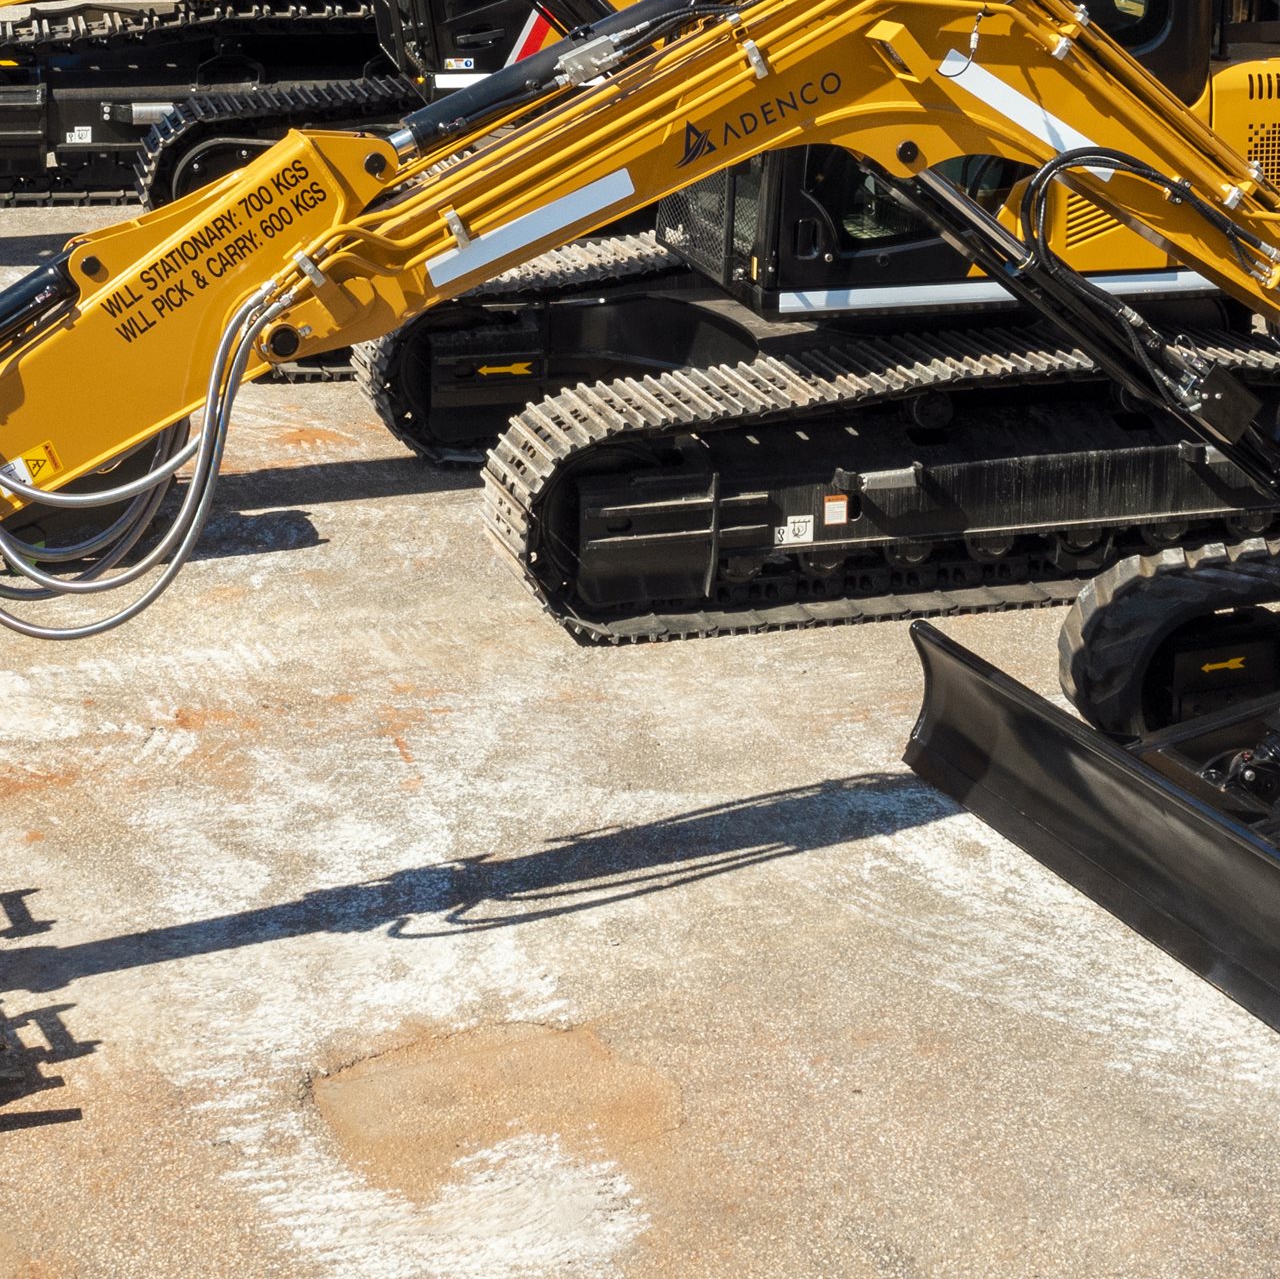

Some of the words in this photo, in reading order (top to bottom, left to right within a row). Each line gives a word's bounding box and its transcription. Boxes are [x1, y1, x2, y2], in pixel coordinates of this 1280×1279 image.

[723, 72, 841, 146] ADENCO
[100, 285, 143, 318] WLL
[140, 209, 243, 291] STATIONARY:
[237, 185, 274, 219] 700
[271, 159, 309, 197] KGS
[115, 310, 157, 344] WLL
[151, 279, 195, 318] PICK
[192, 270, 210, 290] &
[206, 232, 264, 278] CARRY:
[259, 207, 293, 238] 600
[290, 181, 327, 216] KGS
